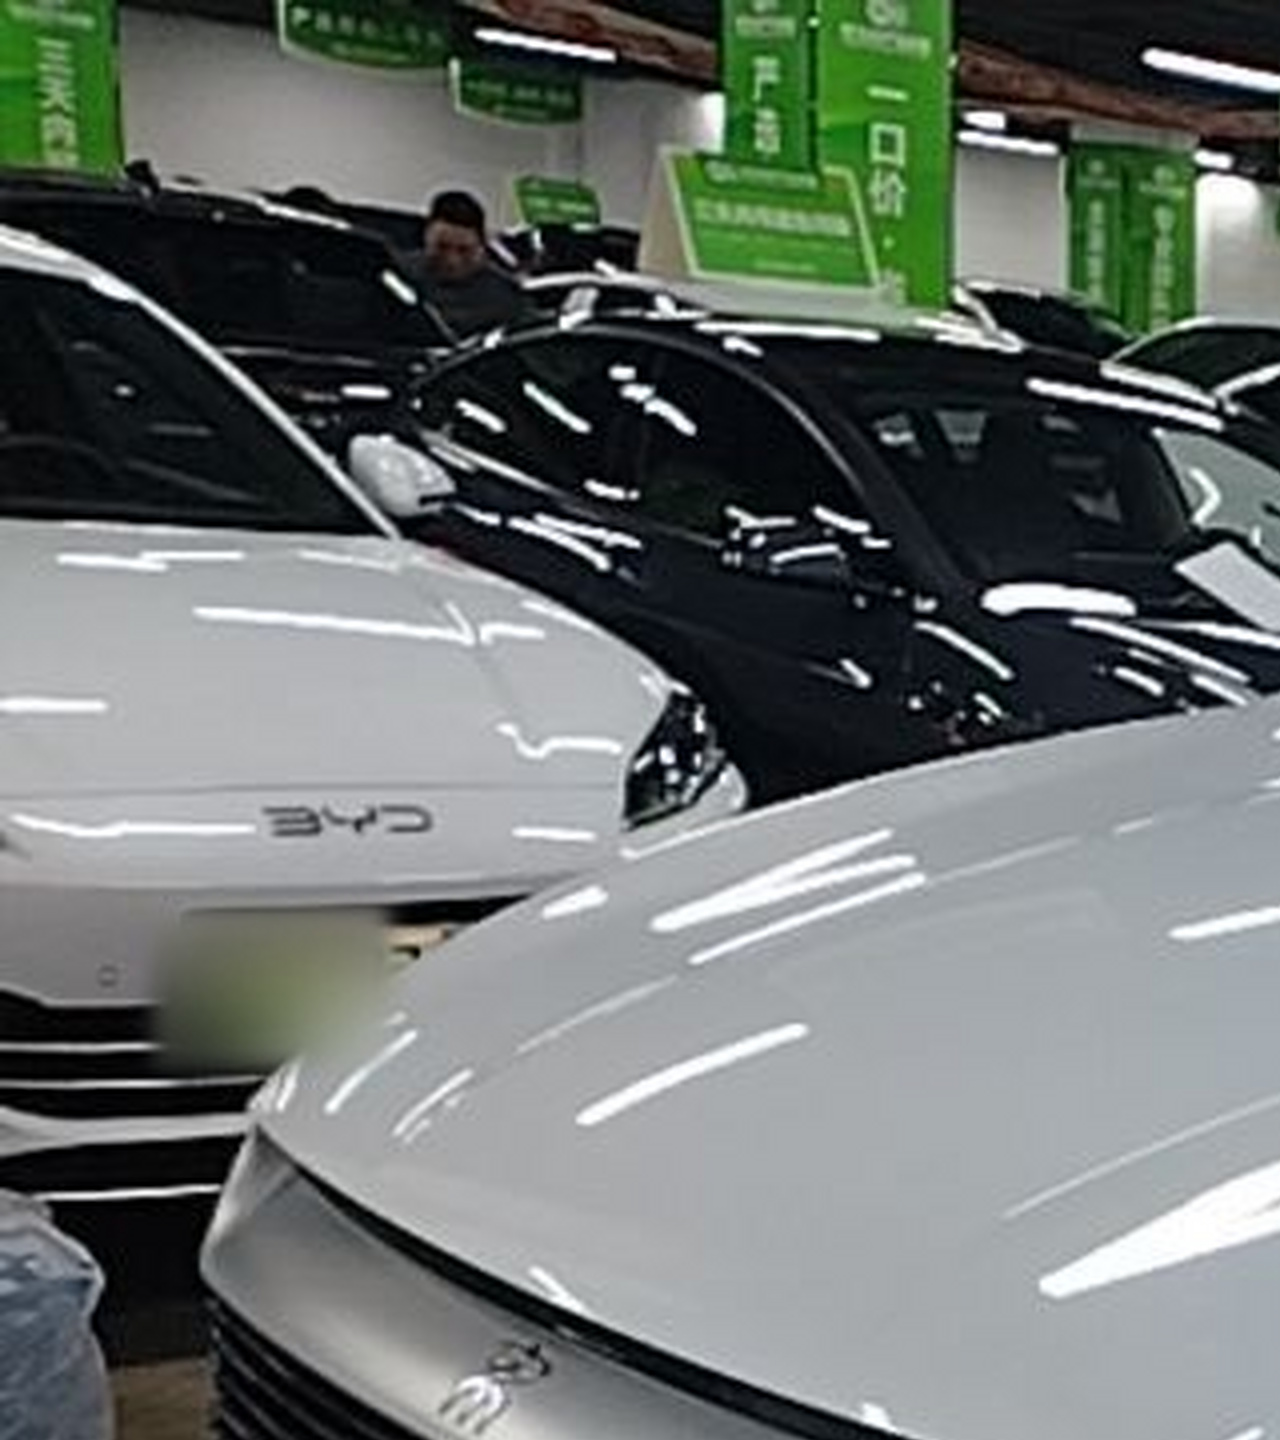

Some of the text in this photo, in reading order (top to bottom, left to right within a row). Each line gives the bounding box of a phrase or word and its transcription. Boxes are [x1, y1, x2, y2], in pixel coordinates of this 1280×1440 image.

[866, 84, 911, 219] 一口价
[262, 805, 433, 838] BYD
